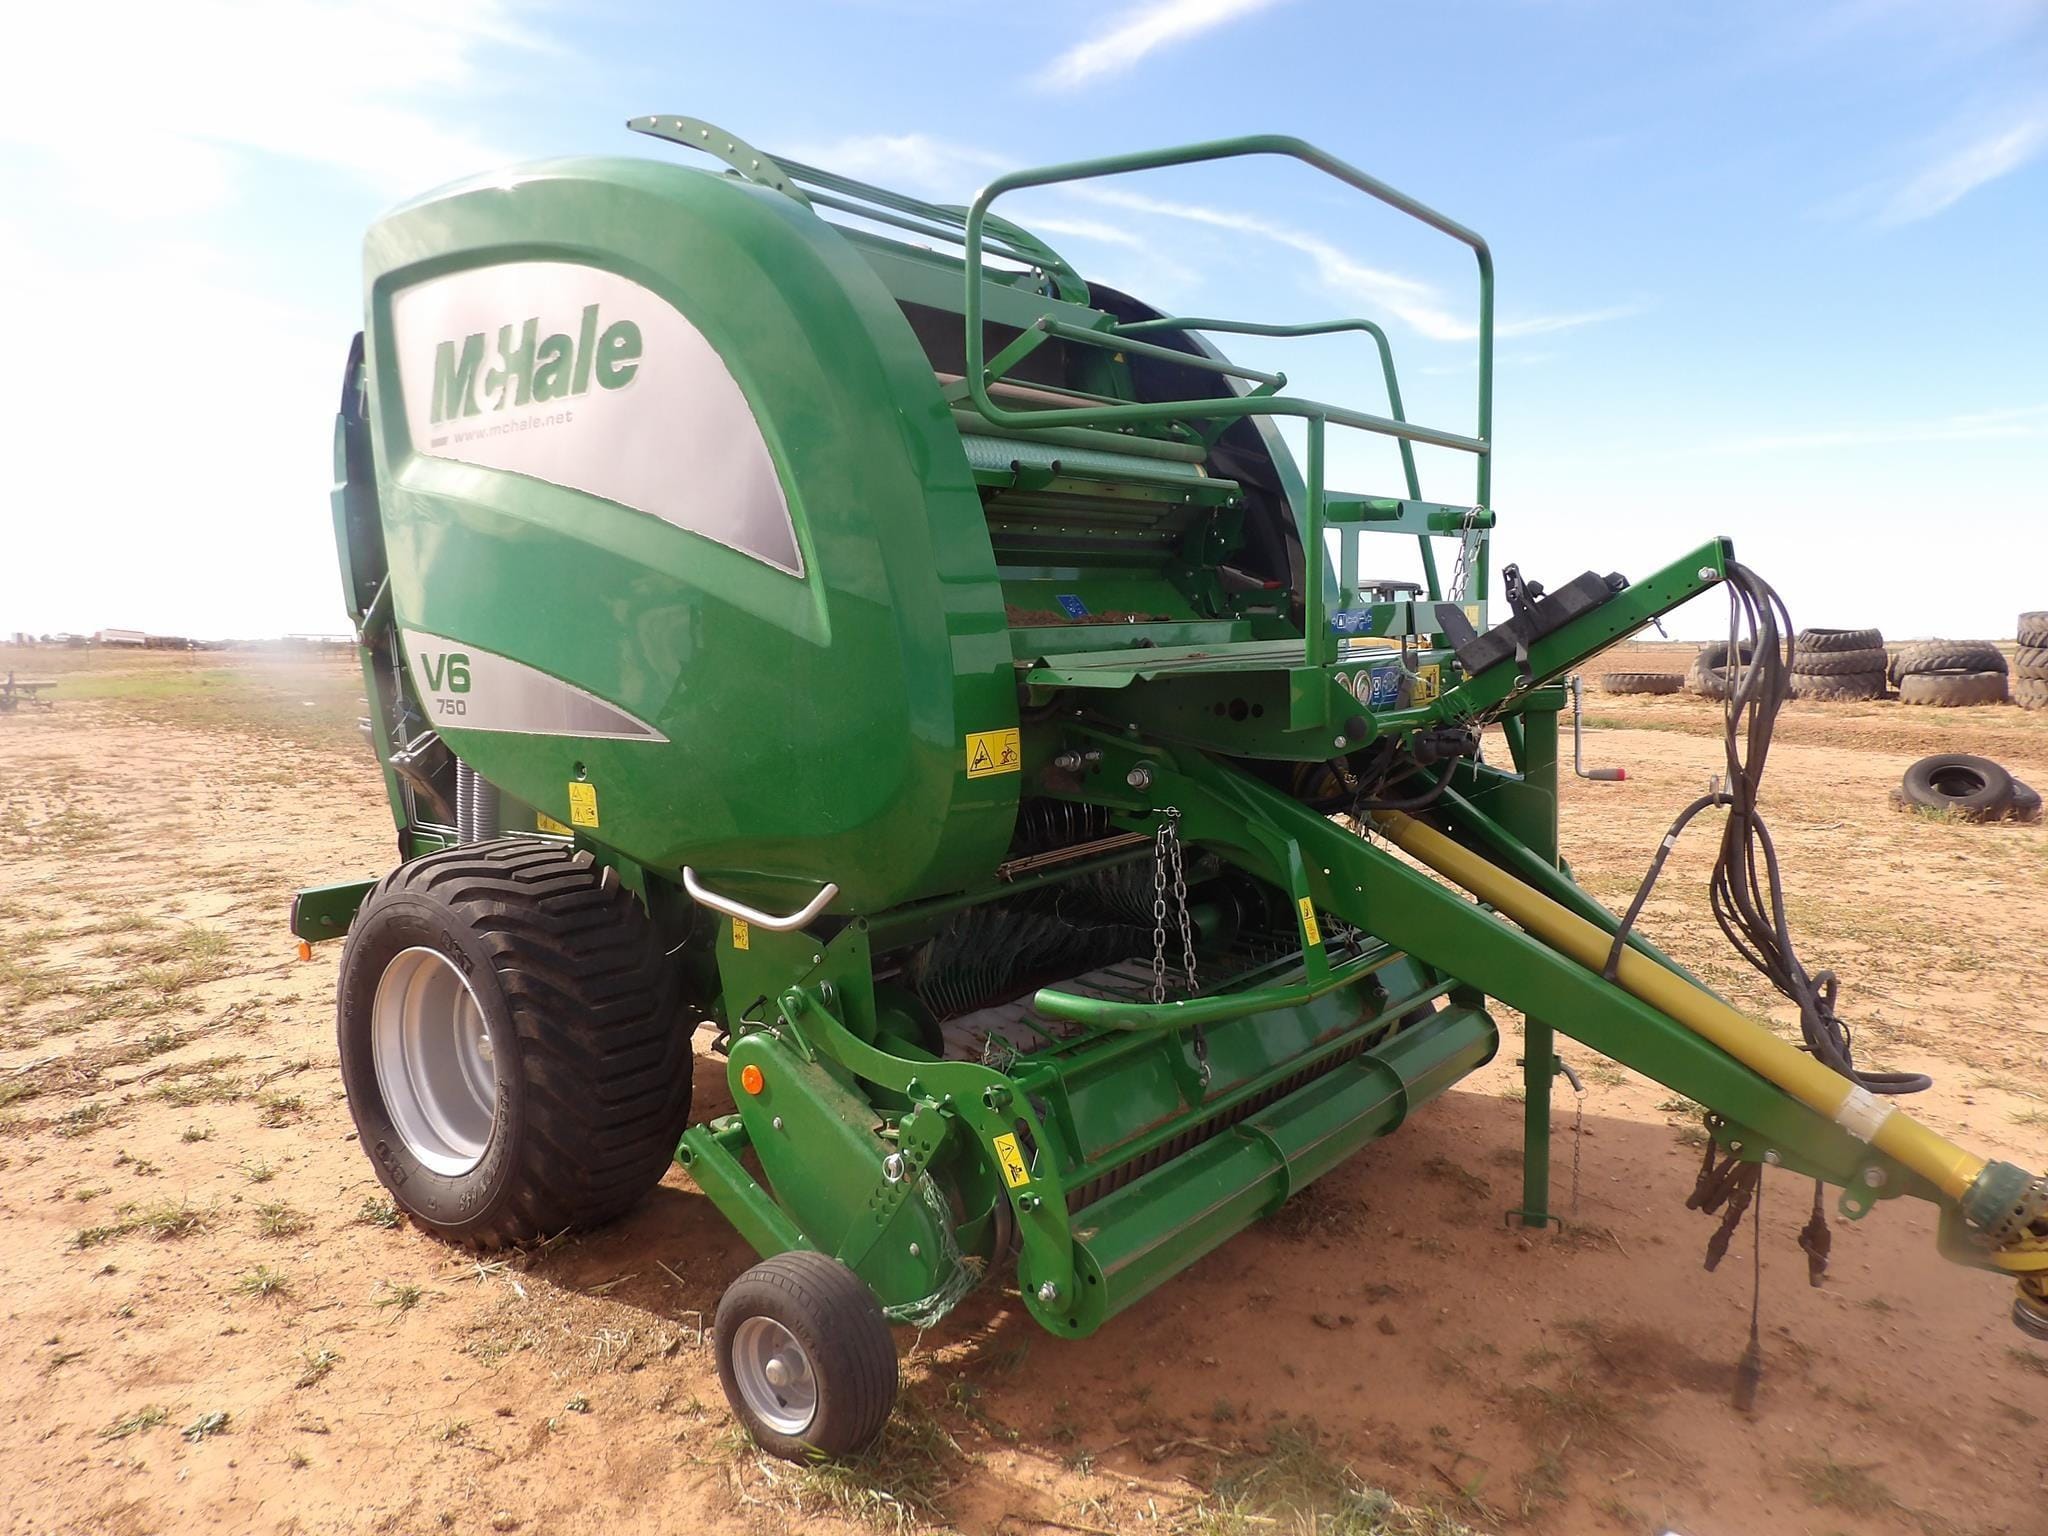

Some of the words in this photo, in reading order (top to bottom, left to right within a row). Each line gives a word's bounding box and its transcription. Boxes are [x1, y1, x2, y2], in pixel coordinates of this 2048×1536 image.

[431, 304, 642, 424] McHale
[454, 411, 573, 443] www.mchale.net
[421, 653, 471, 693] V6
[437, 699, 467, 716] 750
